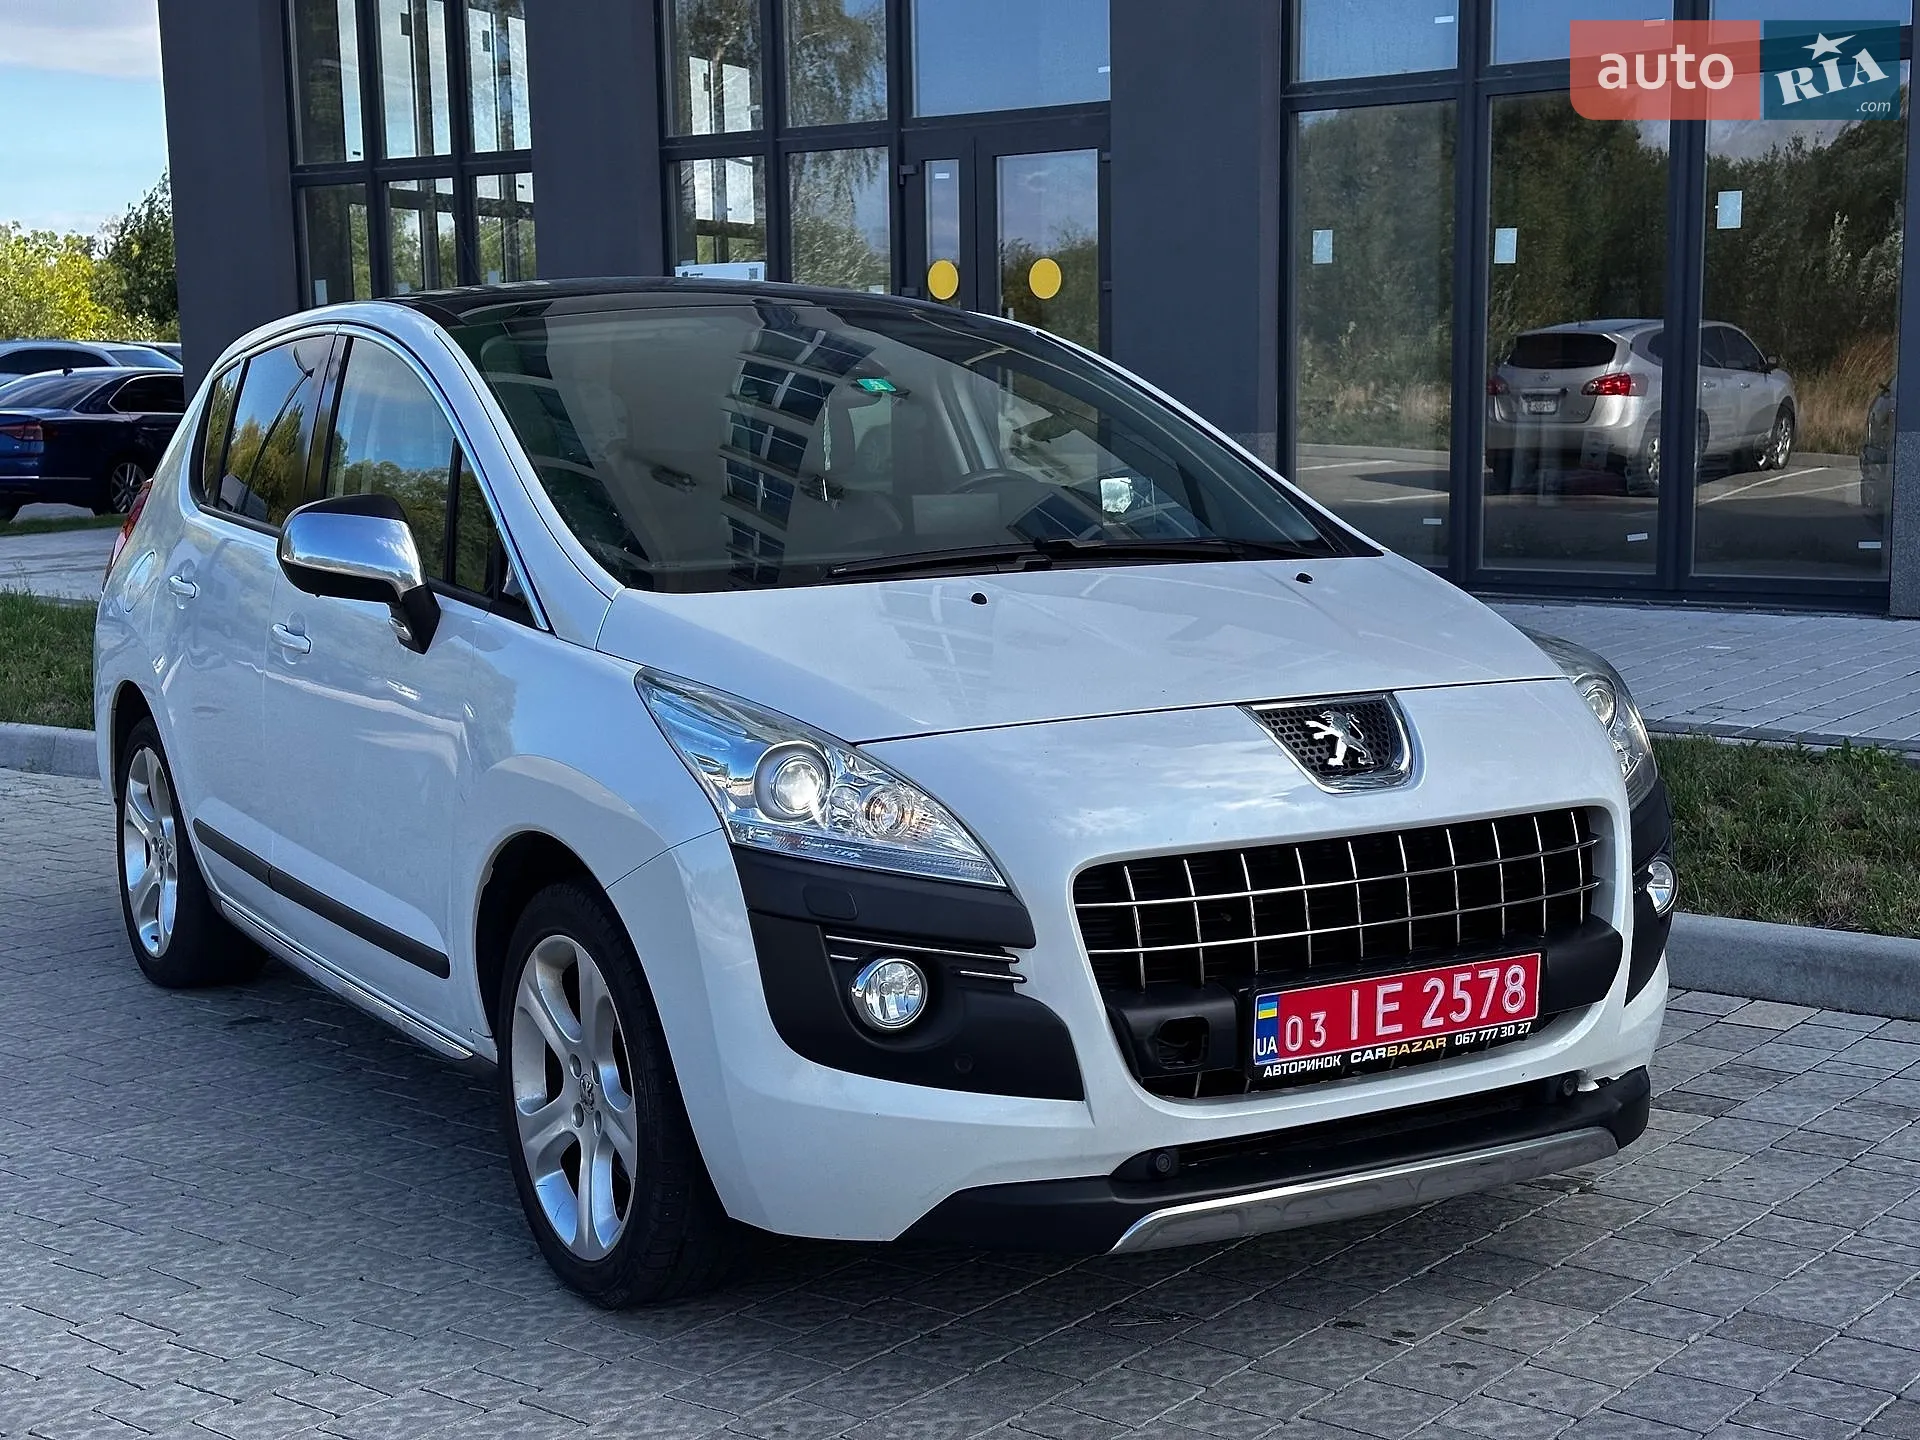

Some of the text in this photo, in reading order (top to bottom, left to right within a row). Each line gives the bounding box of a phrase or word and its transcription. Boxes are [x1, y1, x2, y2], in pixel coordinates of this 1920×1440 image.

[1285, 964, 1526, 1051] 03 IE 2578
[1257, 1035, 1278, 1056] UA
[1263, 1022, 1532, 1078] АВТОРИНОК CARBAZAR 067 777 30 27
